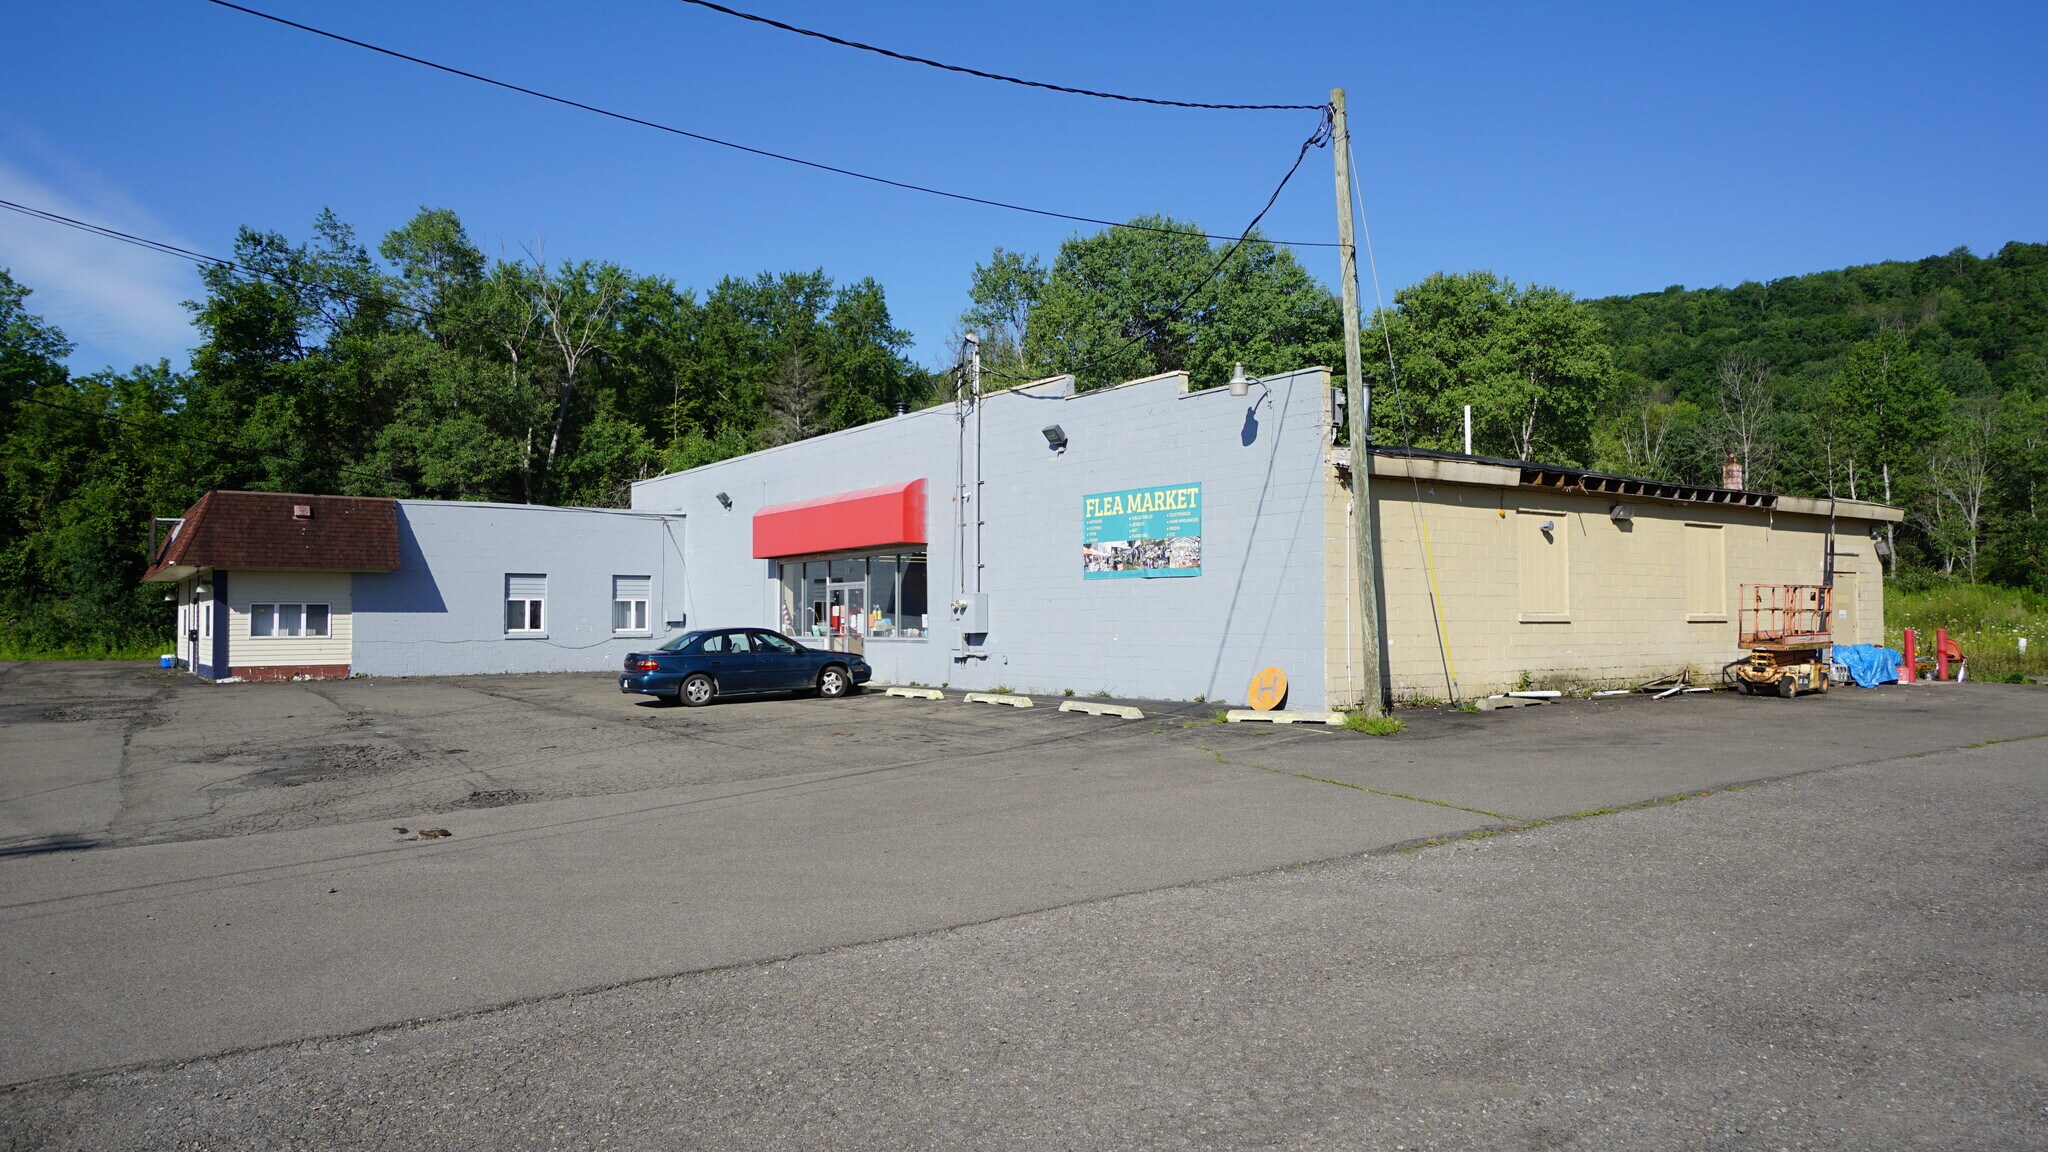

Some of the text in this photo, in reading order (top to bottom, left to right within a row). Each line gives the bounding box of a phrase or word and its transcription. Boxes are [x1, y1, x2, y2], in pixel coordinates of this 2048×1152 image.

[1086, 488, 1198, 517] FLEA MARKET
[1258, 676, 1277, 700] H
